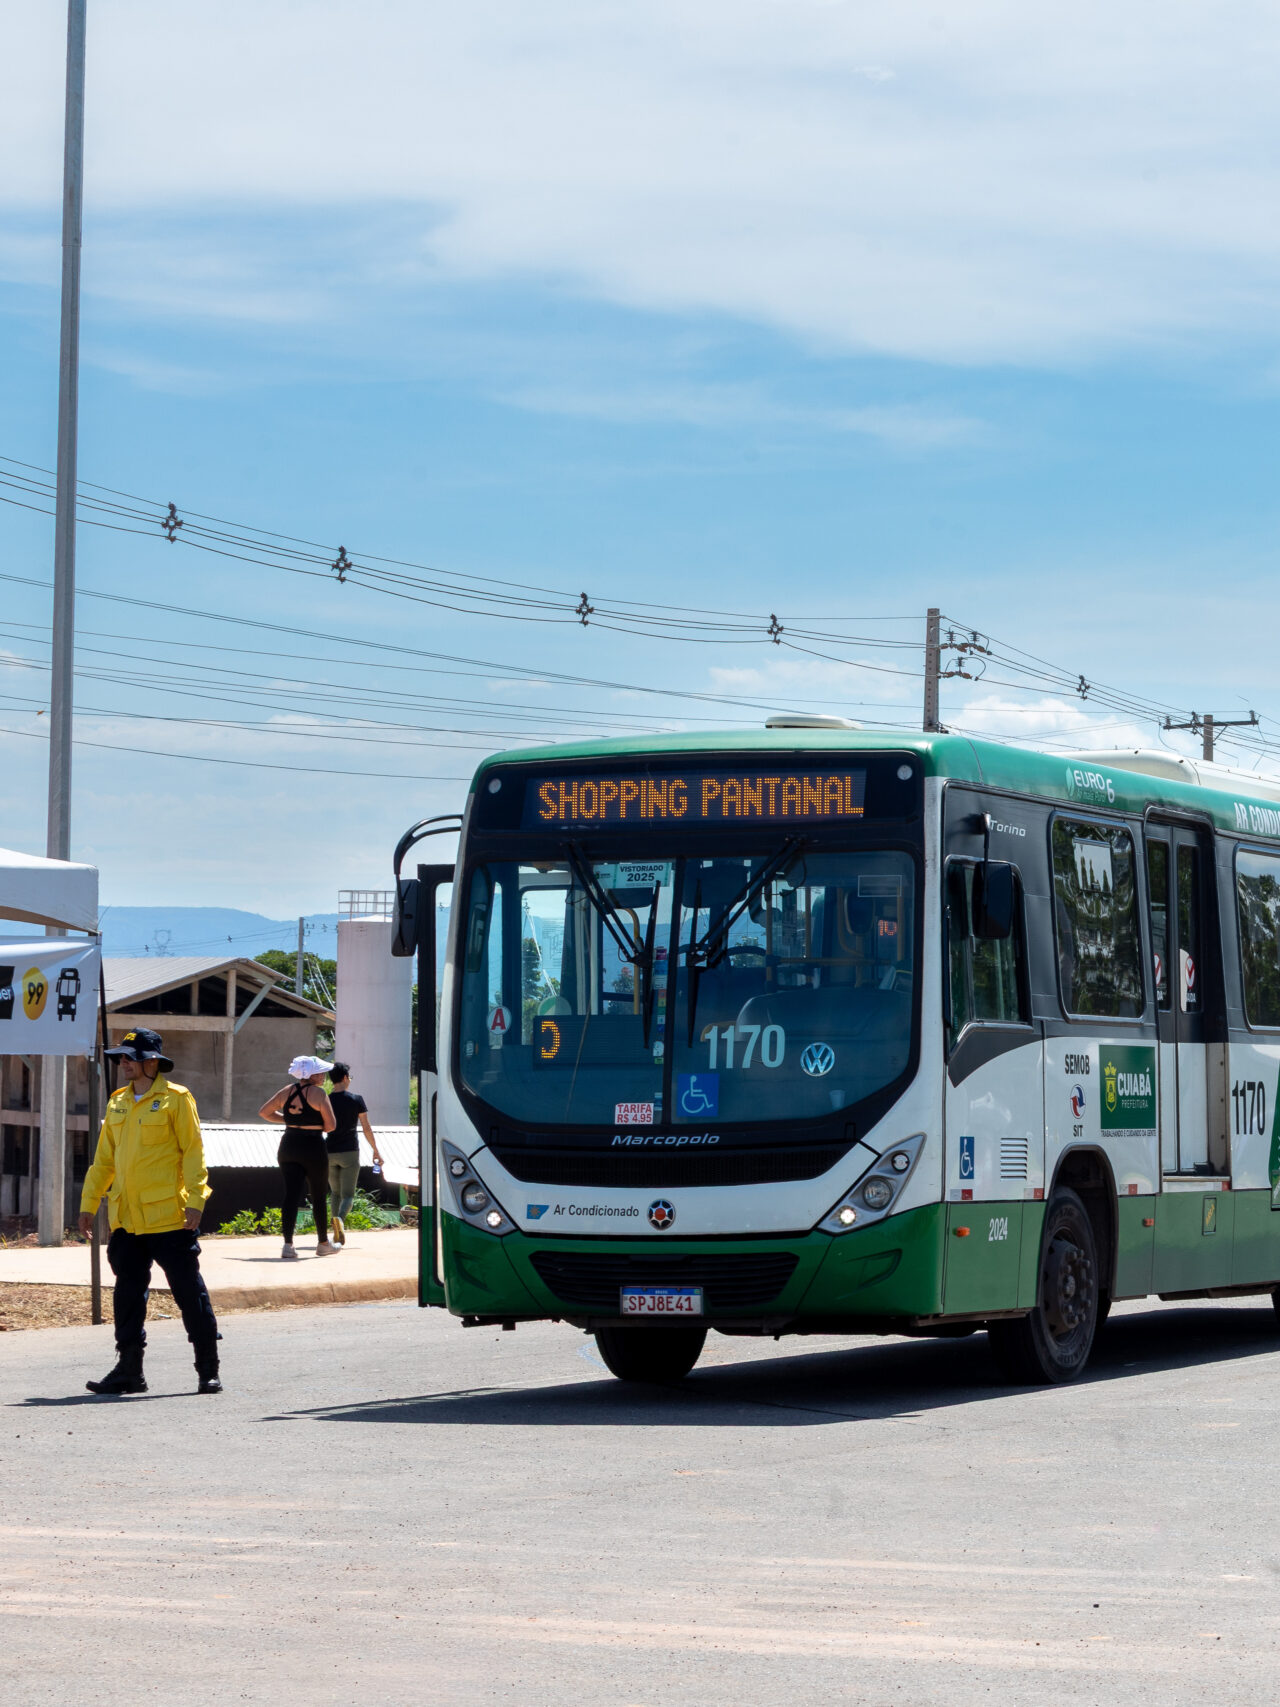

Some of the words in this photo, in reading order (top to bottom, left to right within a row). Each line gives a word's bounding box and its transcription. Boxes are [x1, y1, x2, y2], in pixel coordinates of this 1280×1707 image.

[1073, 770, 1106, 791] EURO
[1106, 779, 1115, 803] 6
[539, 779, 688, 820] SHOPPING
[701, 776, 864, 817] PANTANAL
[1233, 802, 1249, 830] AR
[990, 819, 1026, 837] Torino
[620, 865, 664, 873] VISTORIADO
[626, 872, 655, 882] 2025
[27, 982, 44, 1005] 99
[490, 1008, 507, 1031] A
[704, 1024, 786, 1070] 1170
[1064, 1054, 1090, 1075] SEMOB
[1117, 1067, 1152, 1097] CUIABÁ
[617, 1104, 653, 1114] TARIFA
[1121, 1099, 1149, 1109] PREFEITURA
[1231, 1080, 1266, 1136] 1170
[616, 1113, 630, 1124] R$
[611, 1133, 720, 1147] Marcopolo
[1073, 1124, 1084, 1137] SIT
[553, 1204, 566, 1216] Ar
[568, 1203, 640, 1217] Condicionado
[988, 1216, 1008, 1242] 2024
[628, 1295, 694, 1312] SPJ8E41
